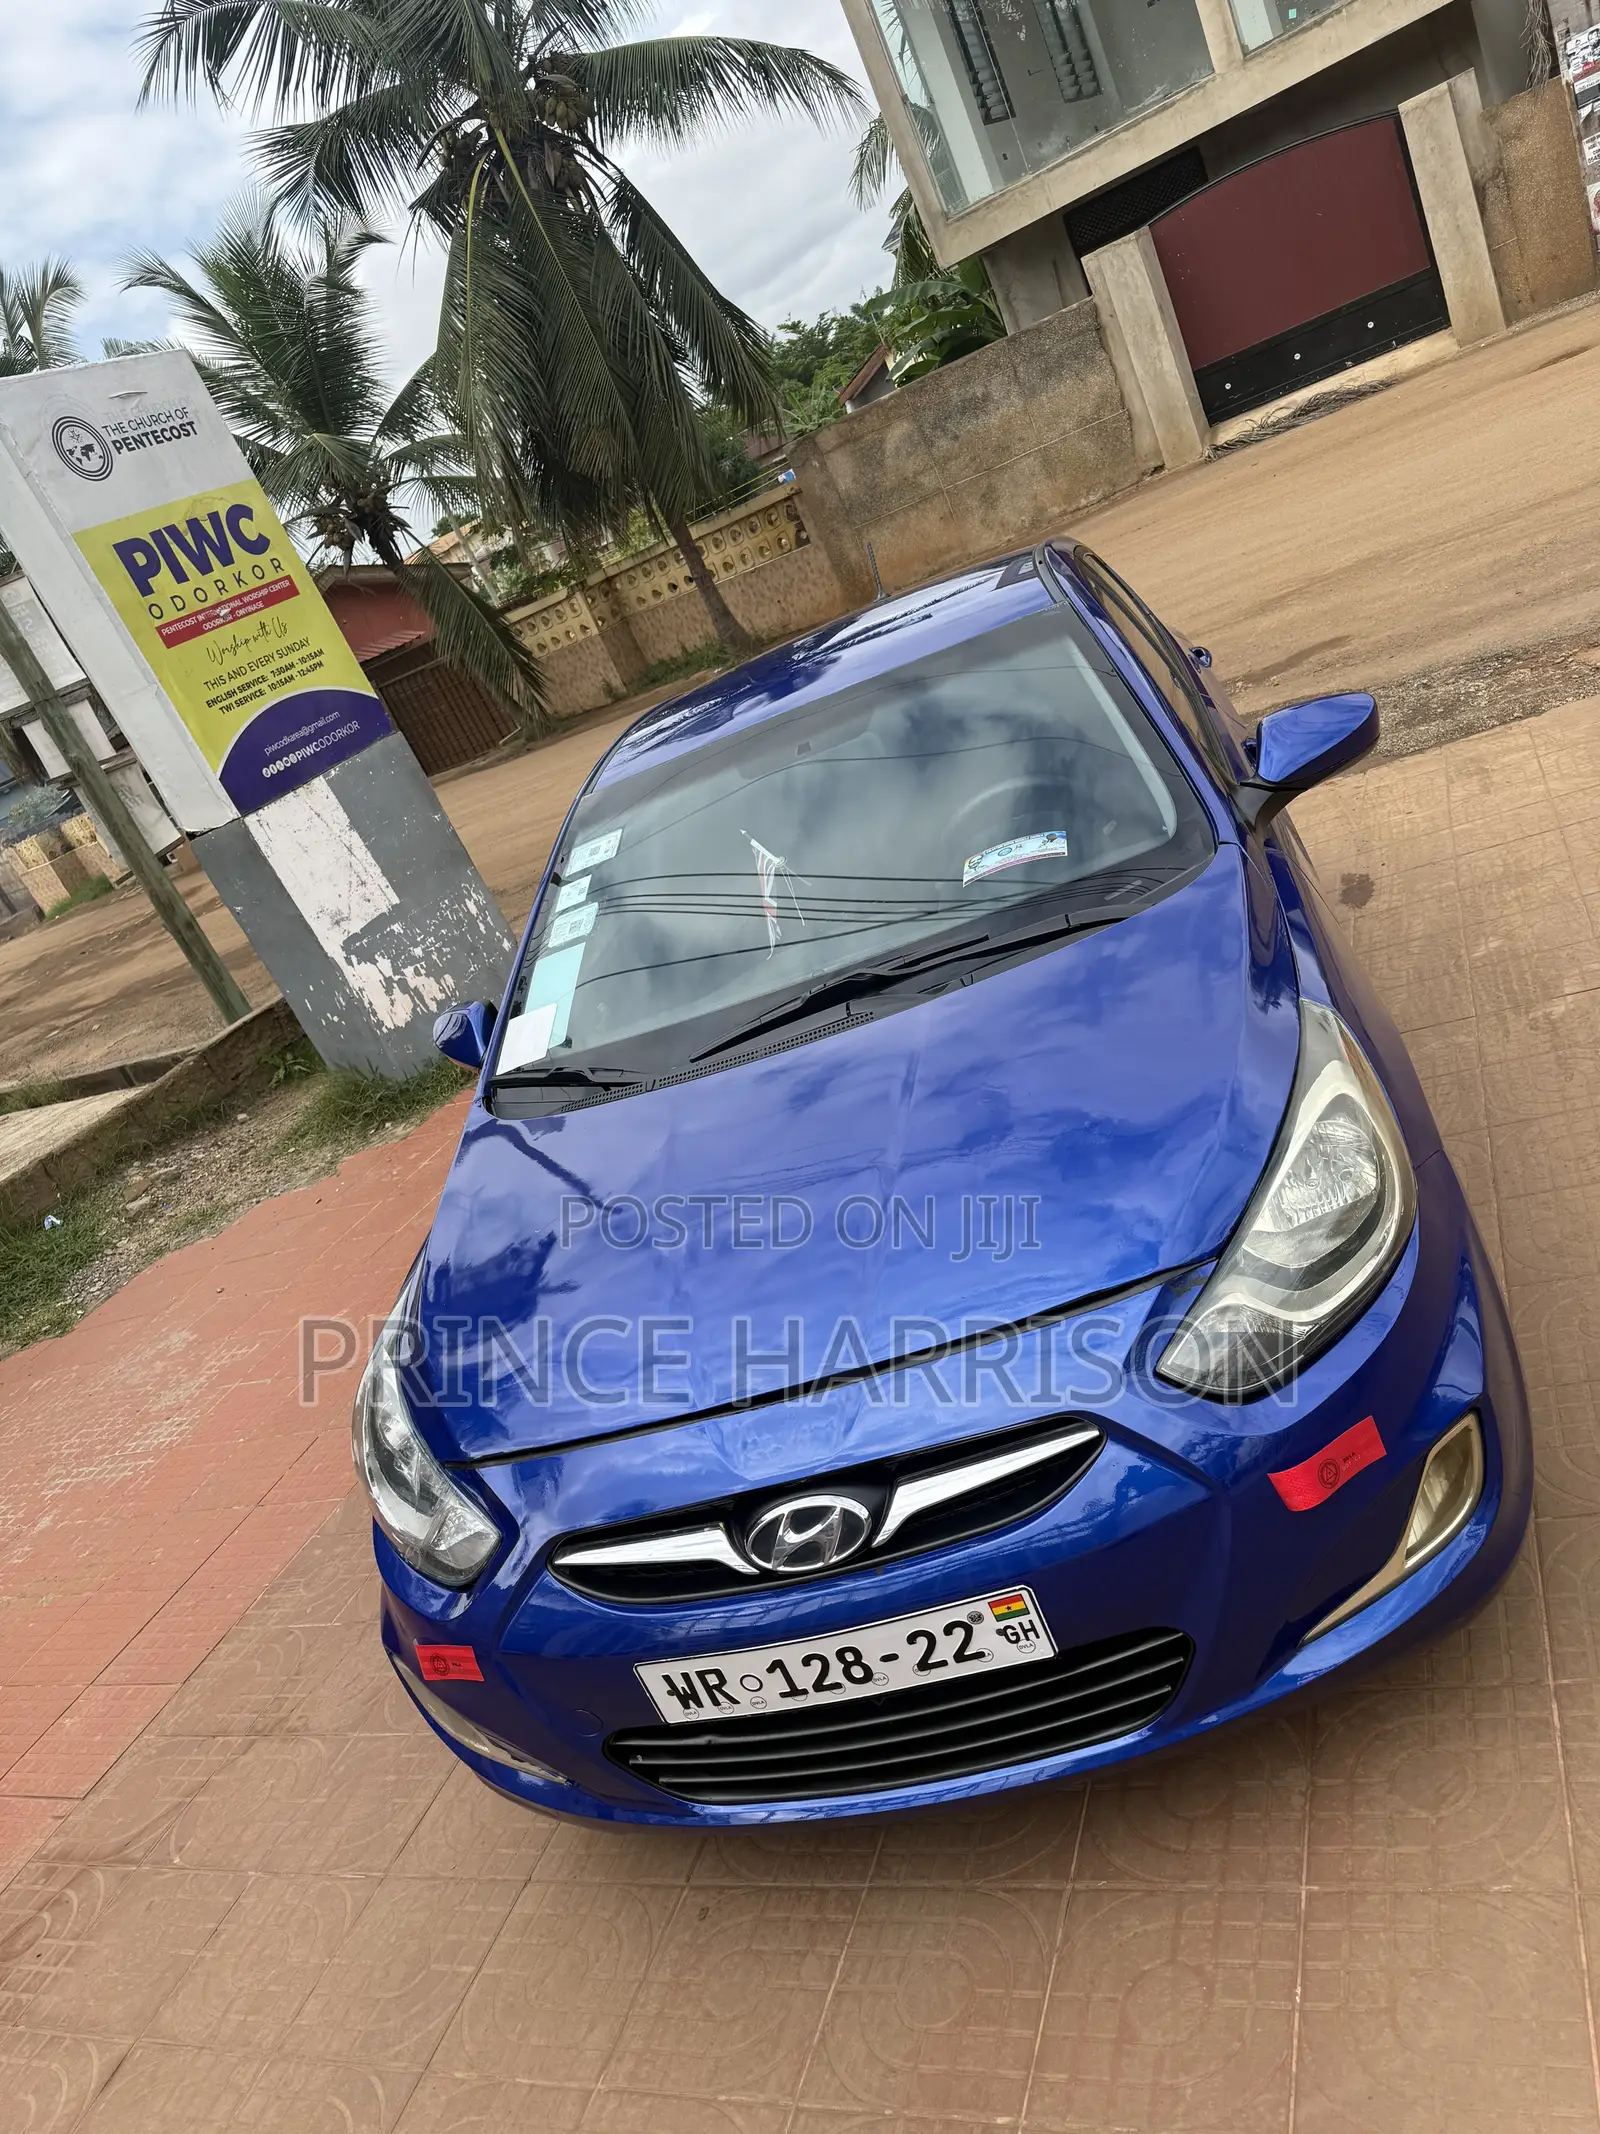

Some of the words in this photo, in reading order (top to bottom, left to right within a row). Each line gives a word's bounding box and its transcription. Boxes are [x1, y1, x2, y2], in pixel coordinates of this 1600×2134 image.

[102, 422, 129, 437] THE
[127, 411, 174, 431] CHURCH
[174, 407, 189, 419] OF
[111, 420, 197, 455] PENTECOST
[112, 504, 271, 598] PIWC
[148, 557, 285, 620] ODORKOR
[161, 616, 198, 636] PENTECOST
[241, 588, 269, 604] WORSHIP
[268, 579, 291, 593] CENTER
[236, 600, 265, 617] ONYINASE
[203, 674, 227, 691] THIS
[228, 665, 248, 682] AND
[247, 652, 276, 673] EVERY
[276, 636, 311, 659] SUNDAY
[206, 634, 252, 666] Worship
[252, 620, 273, 643] with
[271, 616, 288, 639] Us
[205, 688, 238, 709] ENGLISH
[236, 675, 270, 694] SERVICE:
[270, 661, 295, 678] 7:30AM
[298, 648, 325, 666] 10:15AM
[218, 703, 236, 715] TWI
[235, 688, 267, 708] SERVICE:
[267, 674, 296, 692] 10:15AM
[298, 660, 325, 679] 12:45PM
[295, 720, 361, 762] PIWCODORKOR
[1002, 1619, 1040, 1645] GH
[661, 1667, 741, 1710] WR
